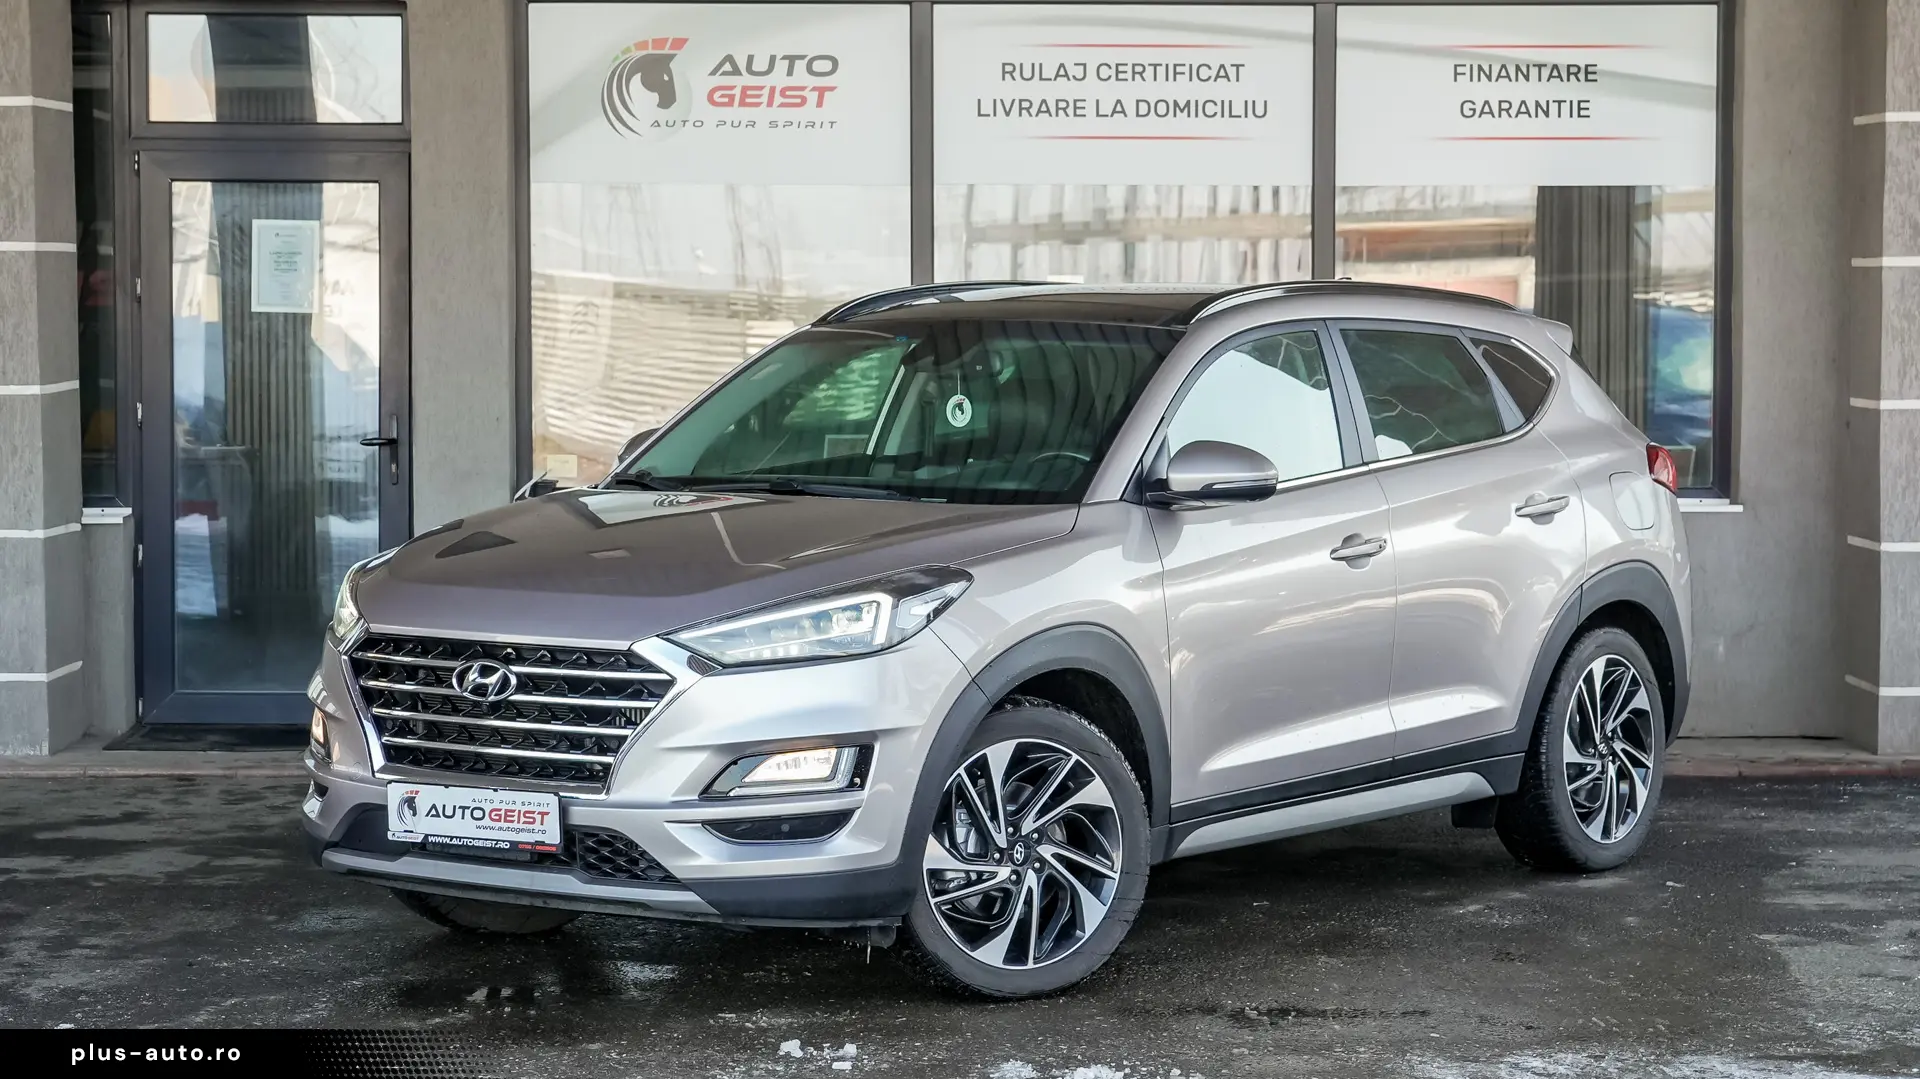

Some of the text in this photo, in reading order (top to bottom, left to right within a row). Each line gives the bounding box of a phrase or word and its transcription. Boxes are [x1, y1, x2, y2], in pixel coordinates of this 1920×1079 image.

[708, 54, 839, 77] AUTO
[1001, 62, 1245, 82] RULAJ CERTIFICAT
[1453, 63, 1598, 82] FINANTARE
[706, 85, 838, 108] GEIST
[977, 98, 1268, 118] LIVRARE LA DOMICILIU
[1460, 100, 1591, 118] GARANTIE
[650, 119, 837, 129] AUTO PUR SPIRIT
[475, 824, 547, 835] www.autogeist.ro
[428, 835, 510, 849] WWW.AUTOGEIST.RO
